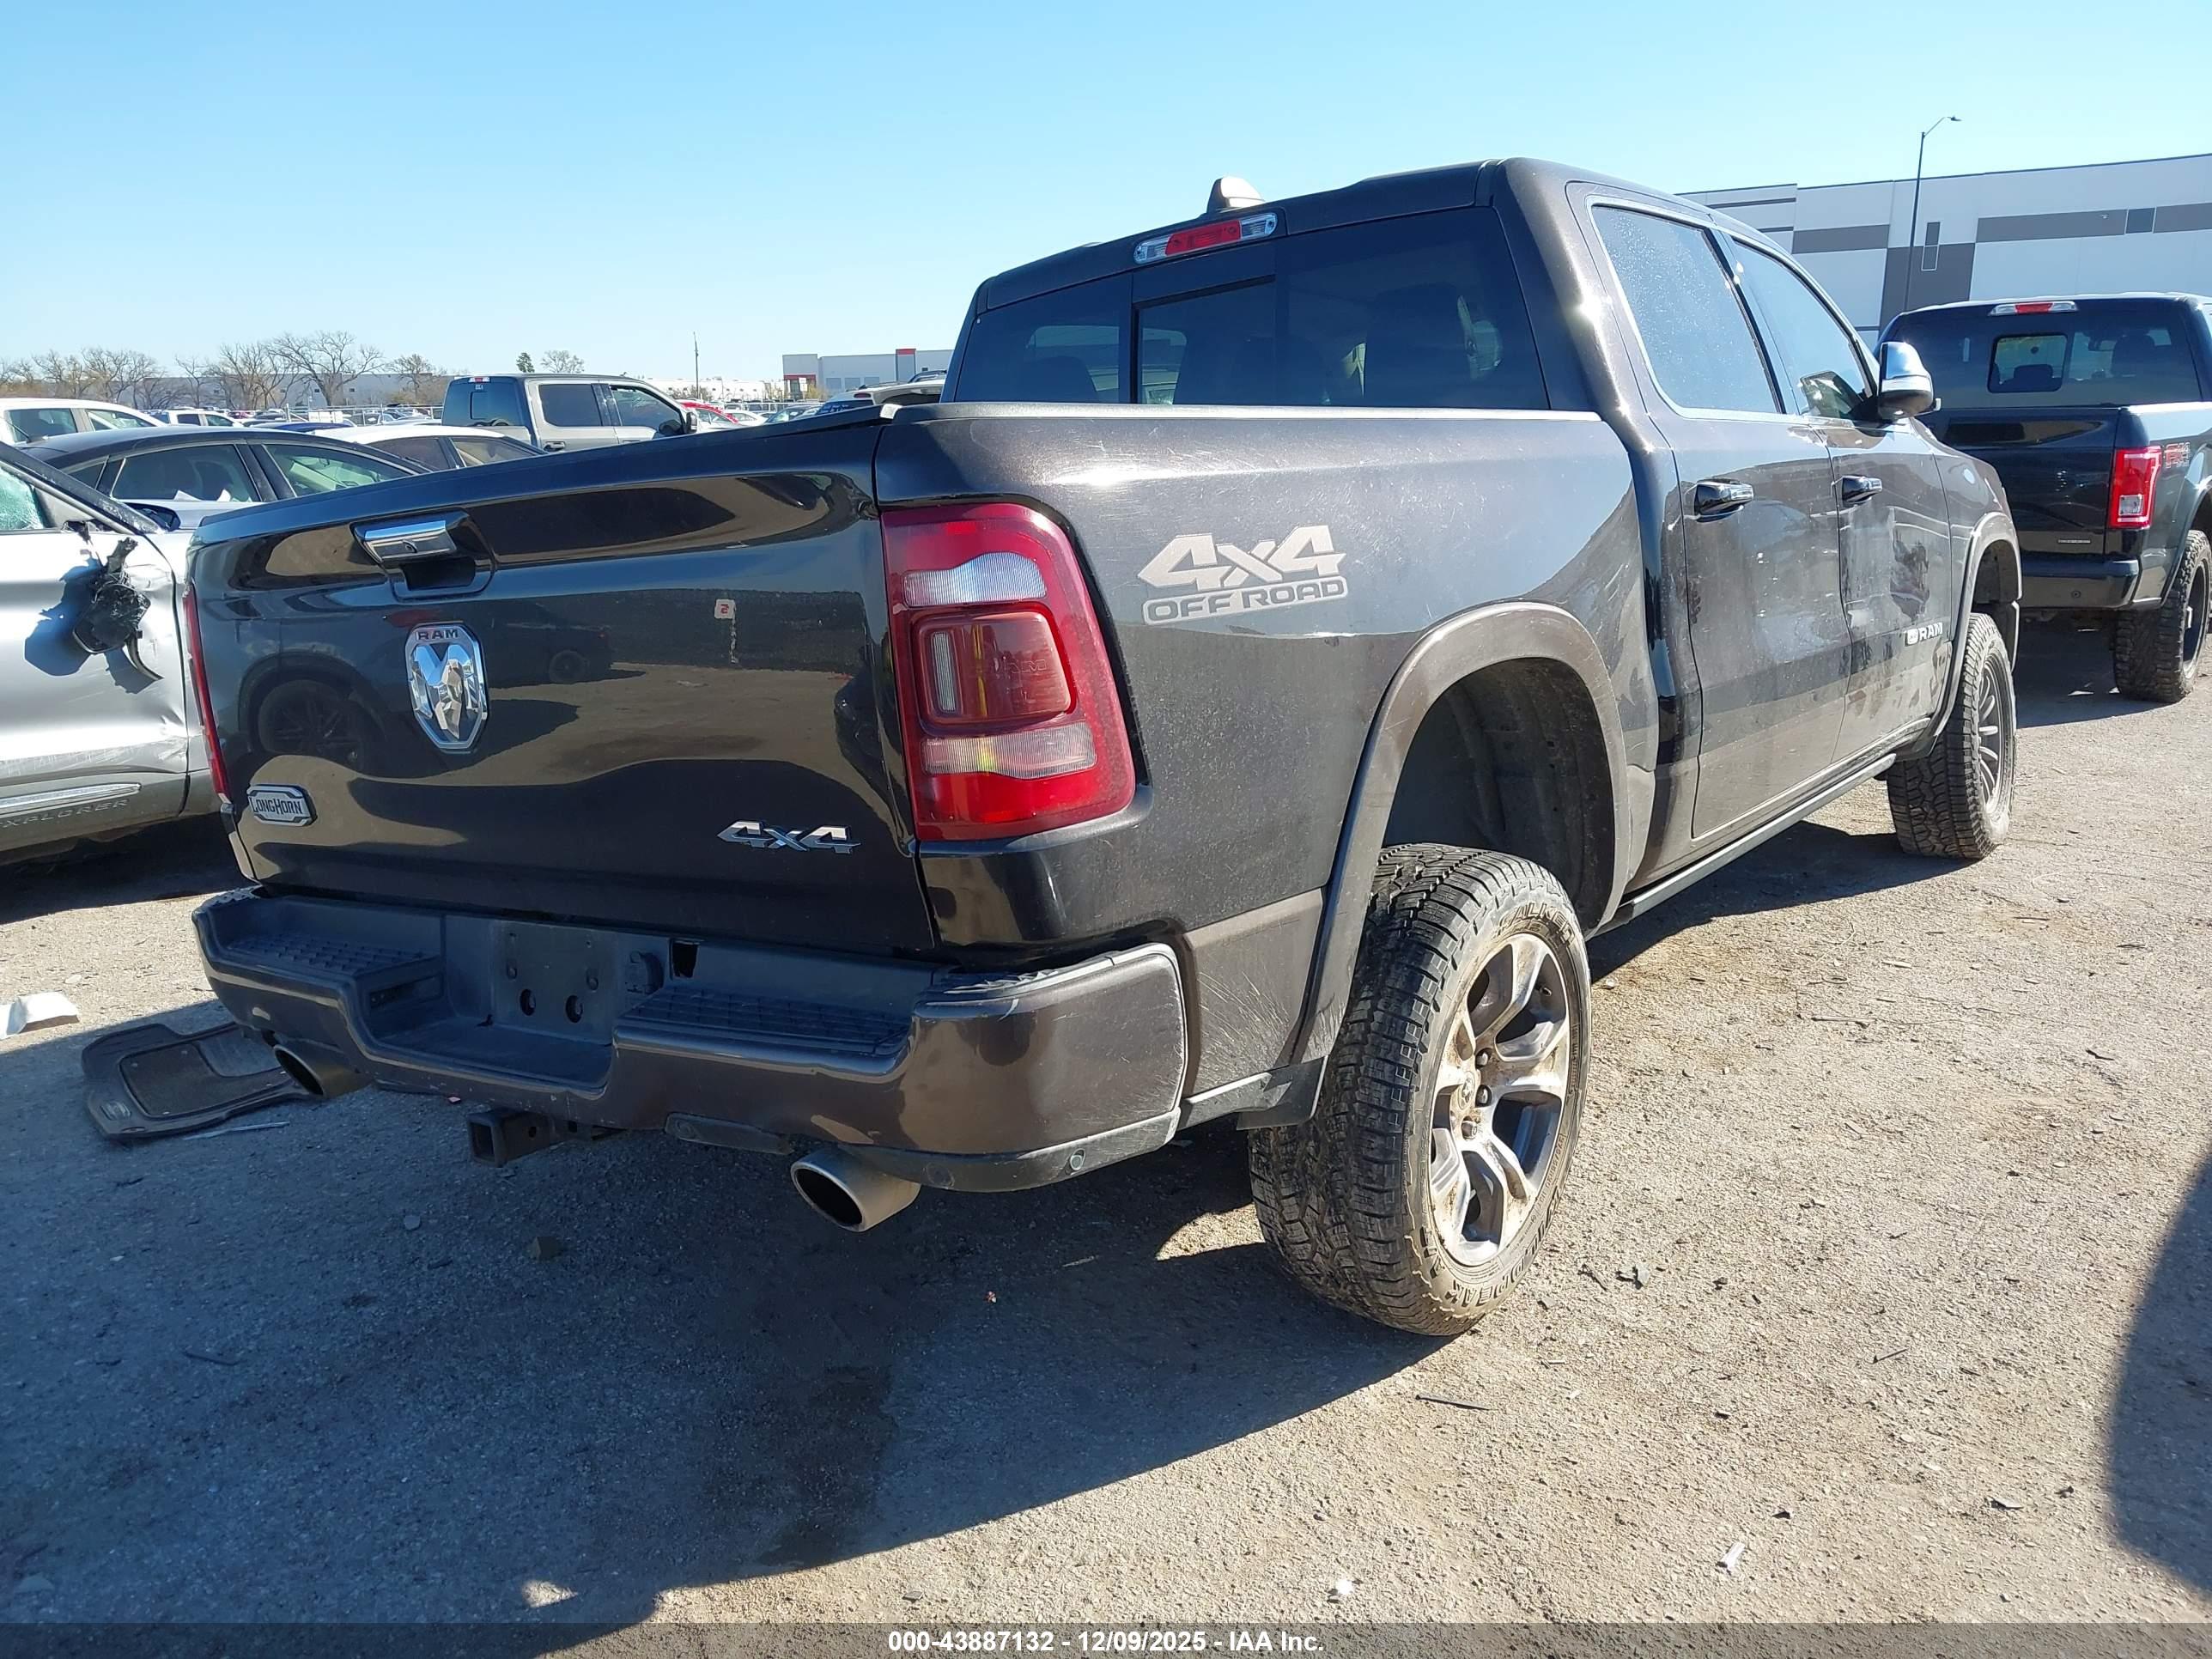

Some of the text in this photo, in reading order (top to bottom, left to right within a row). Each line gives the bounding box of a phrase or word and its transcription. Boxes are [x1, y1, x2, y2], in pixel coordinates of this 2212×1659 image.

[1146, 579, 1346, 622] OFF ROAD
[416, 629, 459, 641] RAM
[1918, 622, 1943, 641] RAM
[0, 799, 130, 828] XPLORER
[249, 797, 303, 815] LONGHORN
